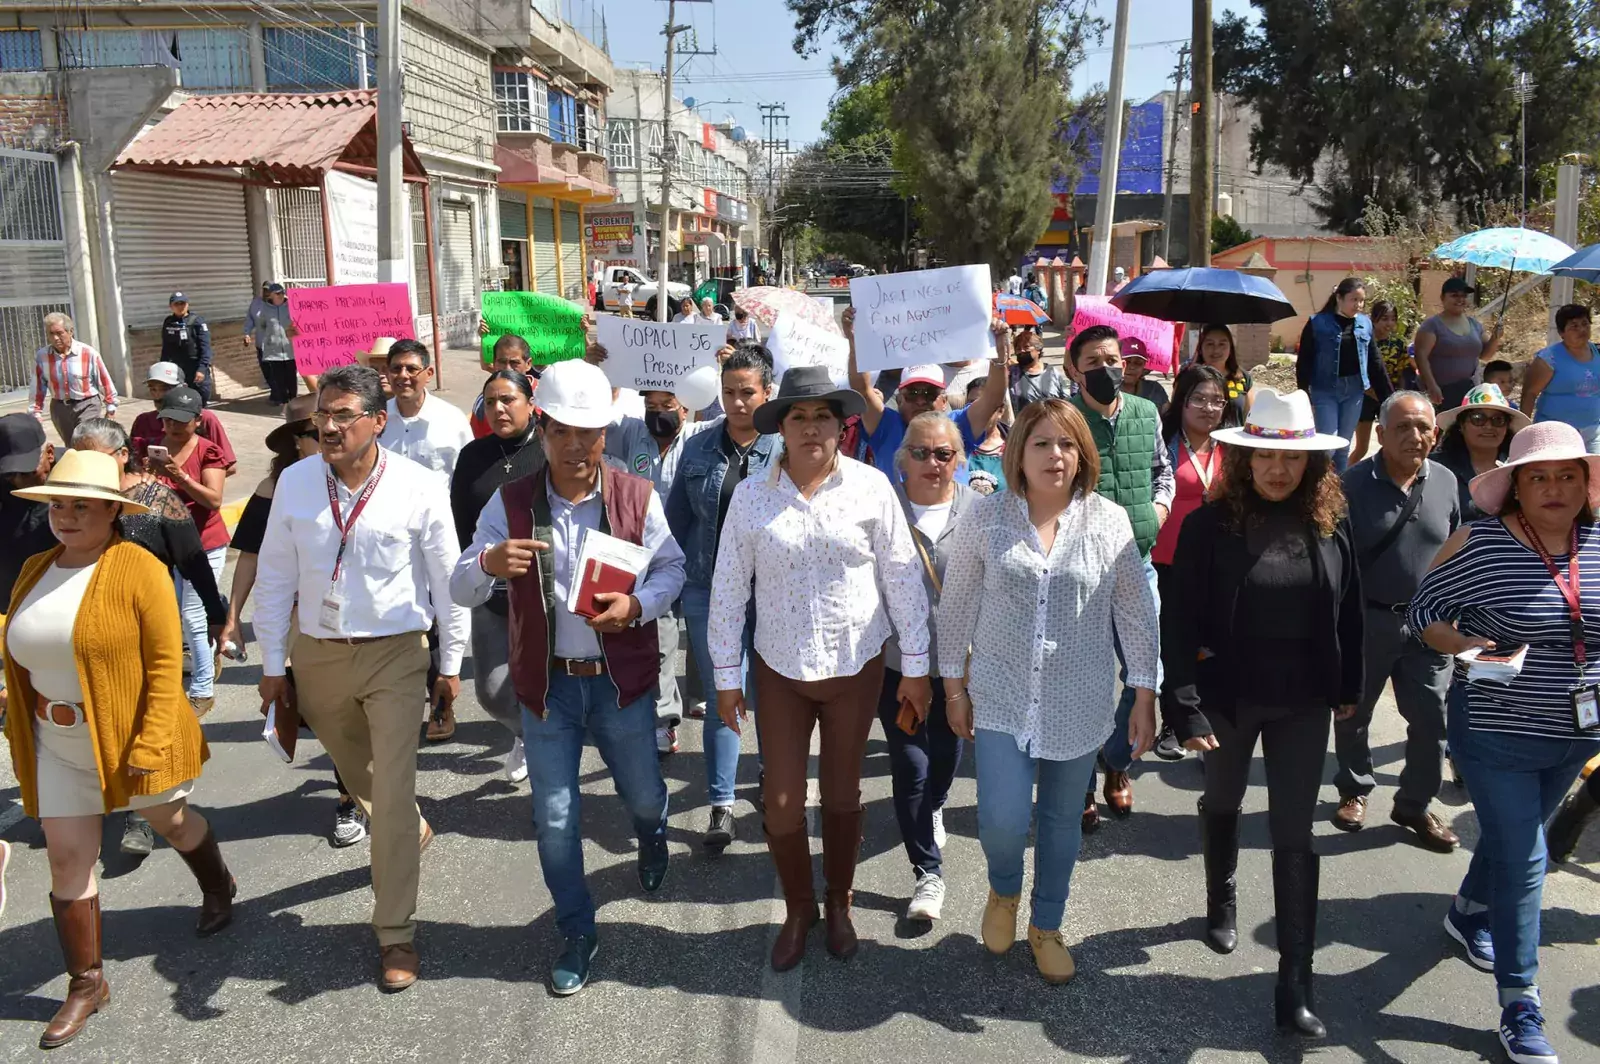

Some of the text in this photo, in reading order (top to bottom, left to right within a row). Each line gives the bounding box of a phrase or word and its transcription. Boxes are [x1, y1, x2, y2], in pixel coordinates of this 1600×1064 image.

[593, 216, 630, 226] SE RENTA
[591, 259, 637, 269] GNERAL
[291, 289, 387, 312] GRACIAS PRESIDENTA
[483, 293, 517, 308] GRACIAS
[869, 281, 961, 309] JARDINES DE
[553, 309, 579, 324] JIMENE
[871, 304, 951, 326] SAN AGUSTIN
[622, 323, 677, 350] COPACI
[882, 329, 948, 358] PRESENTE
[548, 341, 583, 360] AGUSTIN
[643, 352, 698, 376] Present
[634, 378, 675, 388] Bienven
